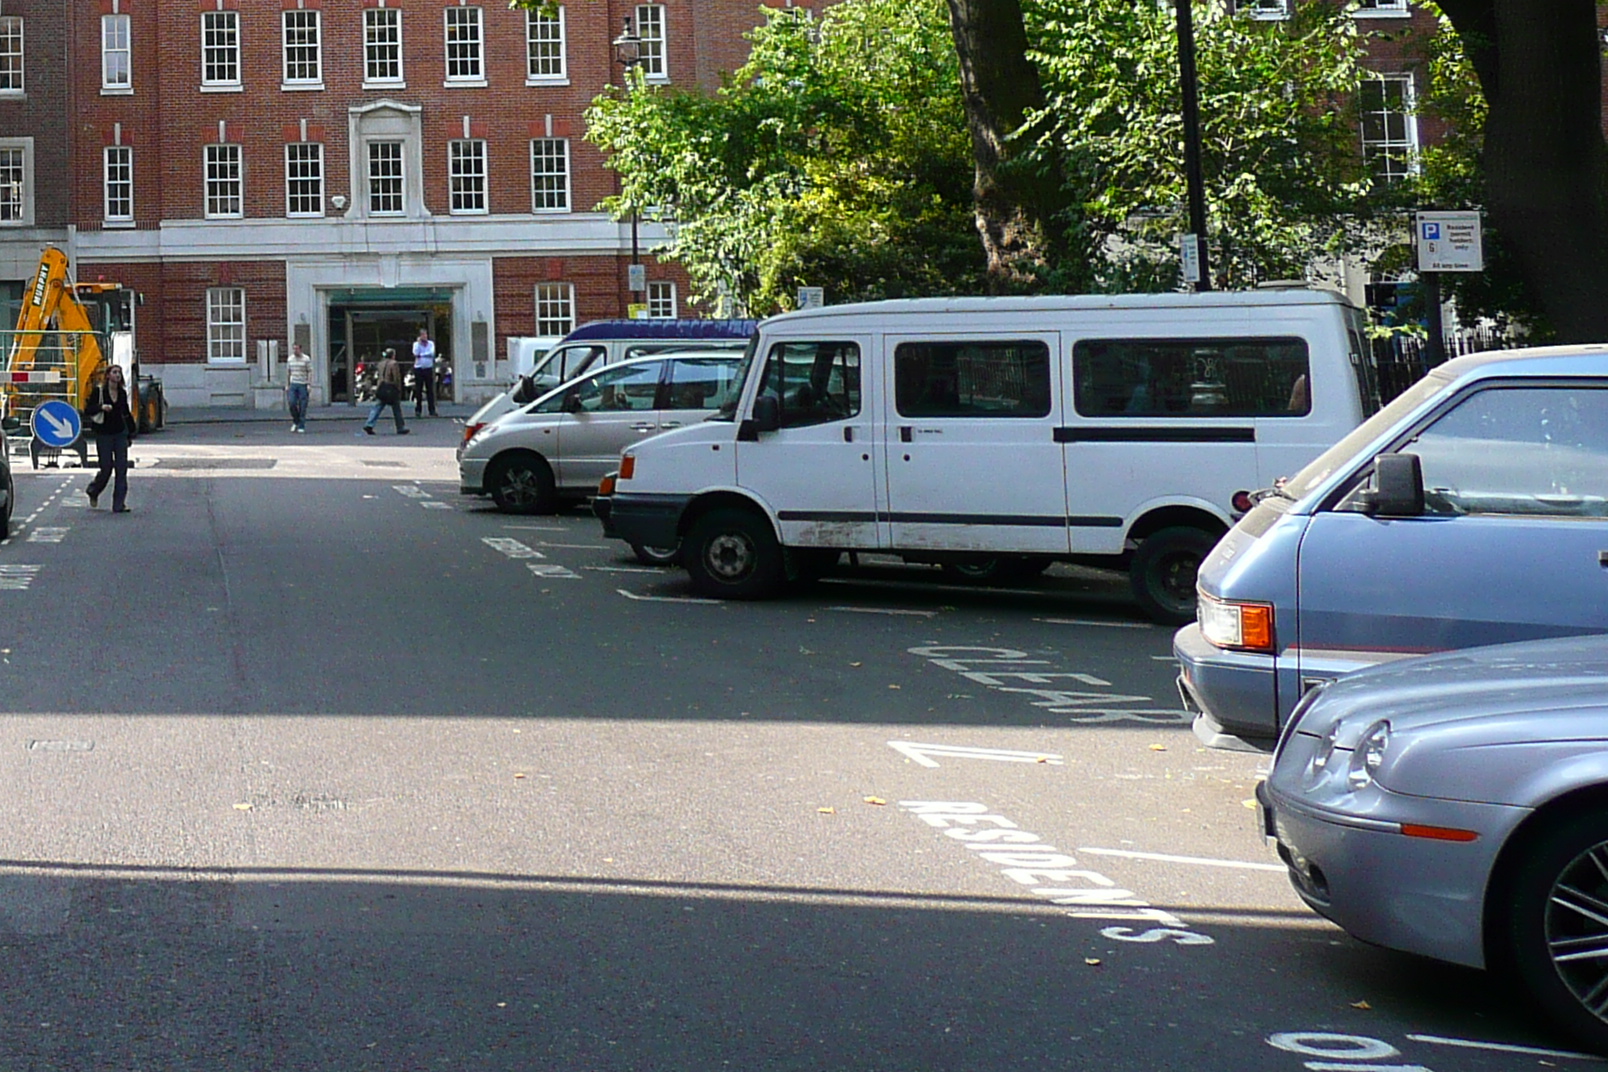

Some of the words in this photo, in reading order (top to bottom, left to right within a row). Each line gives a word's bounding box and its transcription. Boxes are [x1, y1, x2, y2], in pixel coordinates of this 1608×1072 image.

[32, 263, 49, 306] MURPHY
[907, 645, 1197, 724] CLEAR
[898, 800, 1216, 945] RESIDENTS
